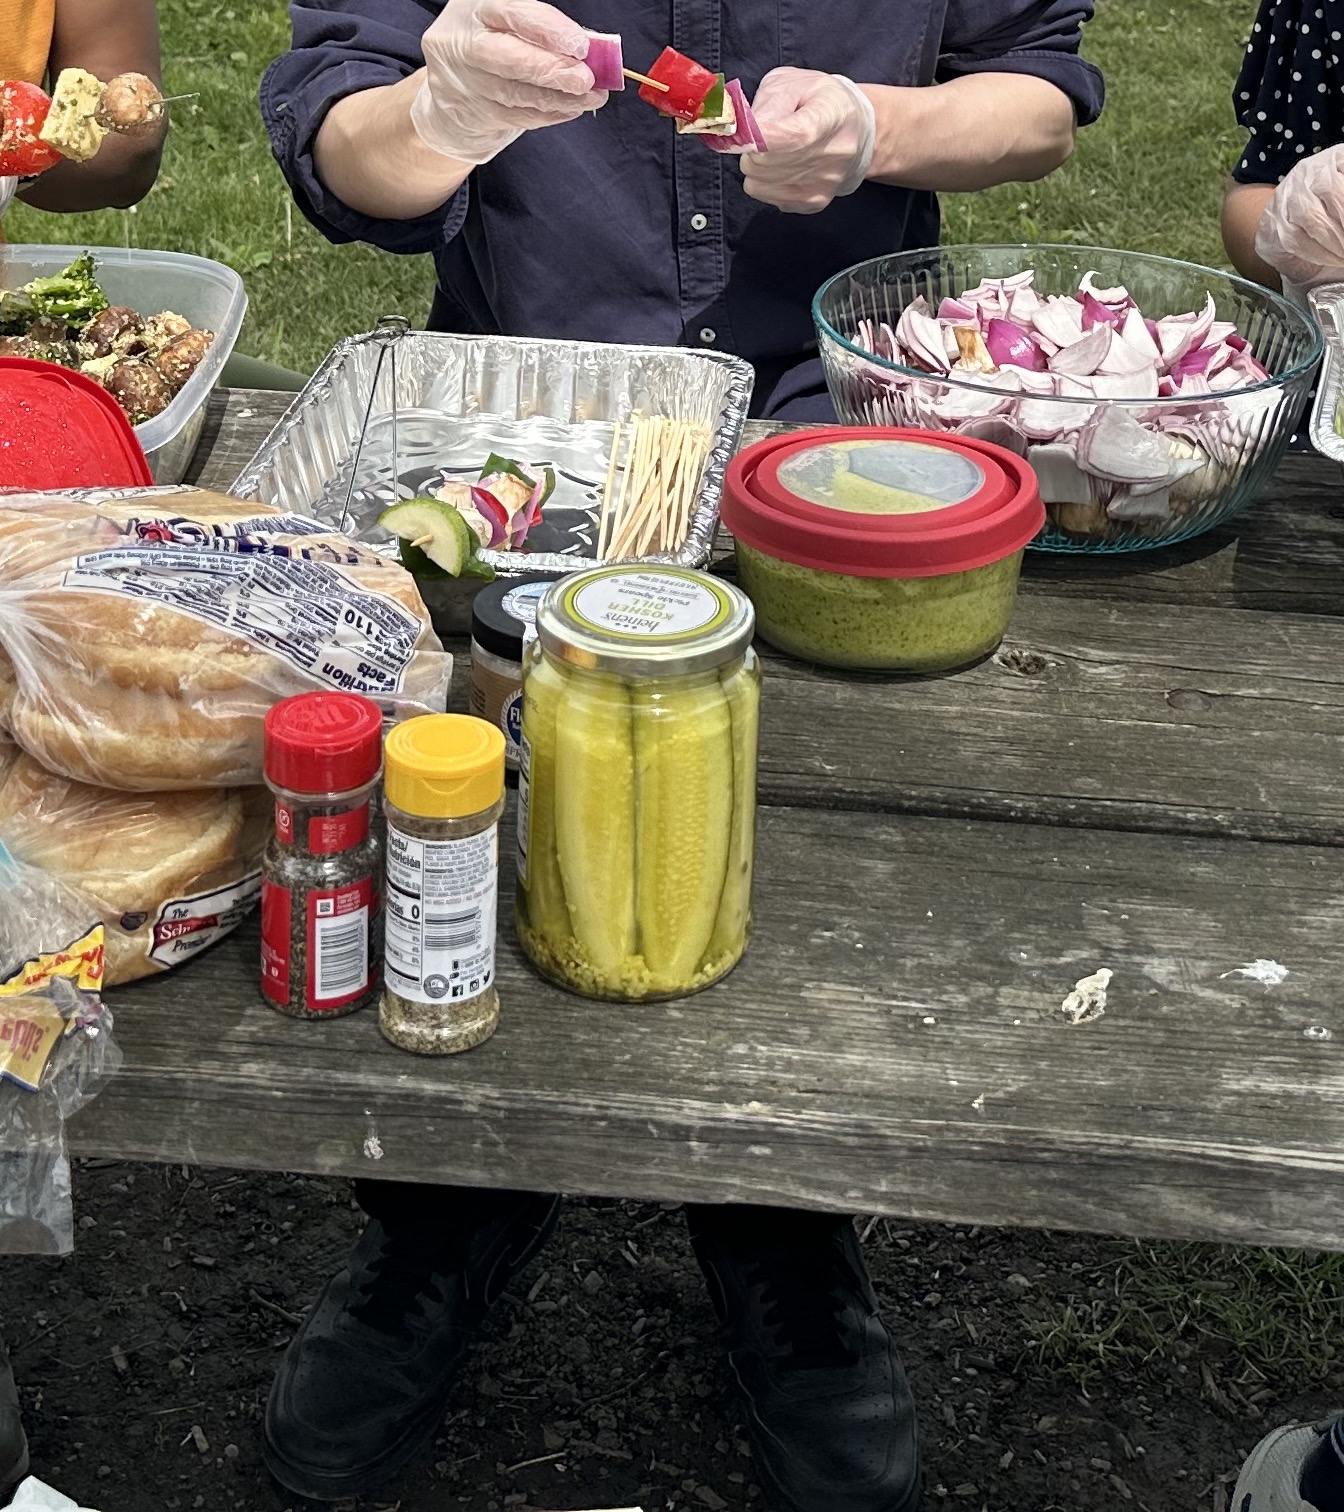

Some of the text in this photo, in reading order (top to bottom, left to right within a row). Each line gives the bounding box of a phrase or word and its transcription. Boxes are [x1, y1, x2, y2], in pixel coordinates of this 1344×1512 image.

[618, 588, 655, 600] Spears
[657, 595, 690, 606] Pickle
[608, 601, 674, 620] KOSHER
[632, 598, 666, 610] DILL
[344, 609, 373, 635] 110
[357, 662, 396, 687] Facts
[172, 908, 188, 919] The
[411, 904, 420, 919] 0
